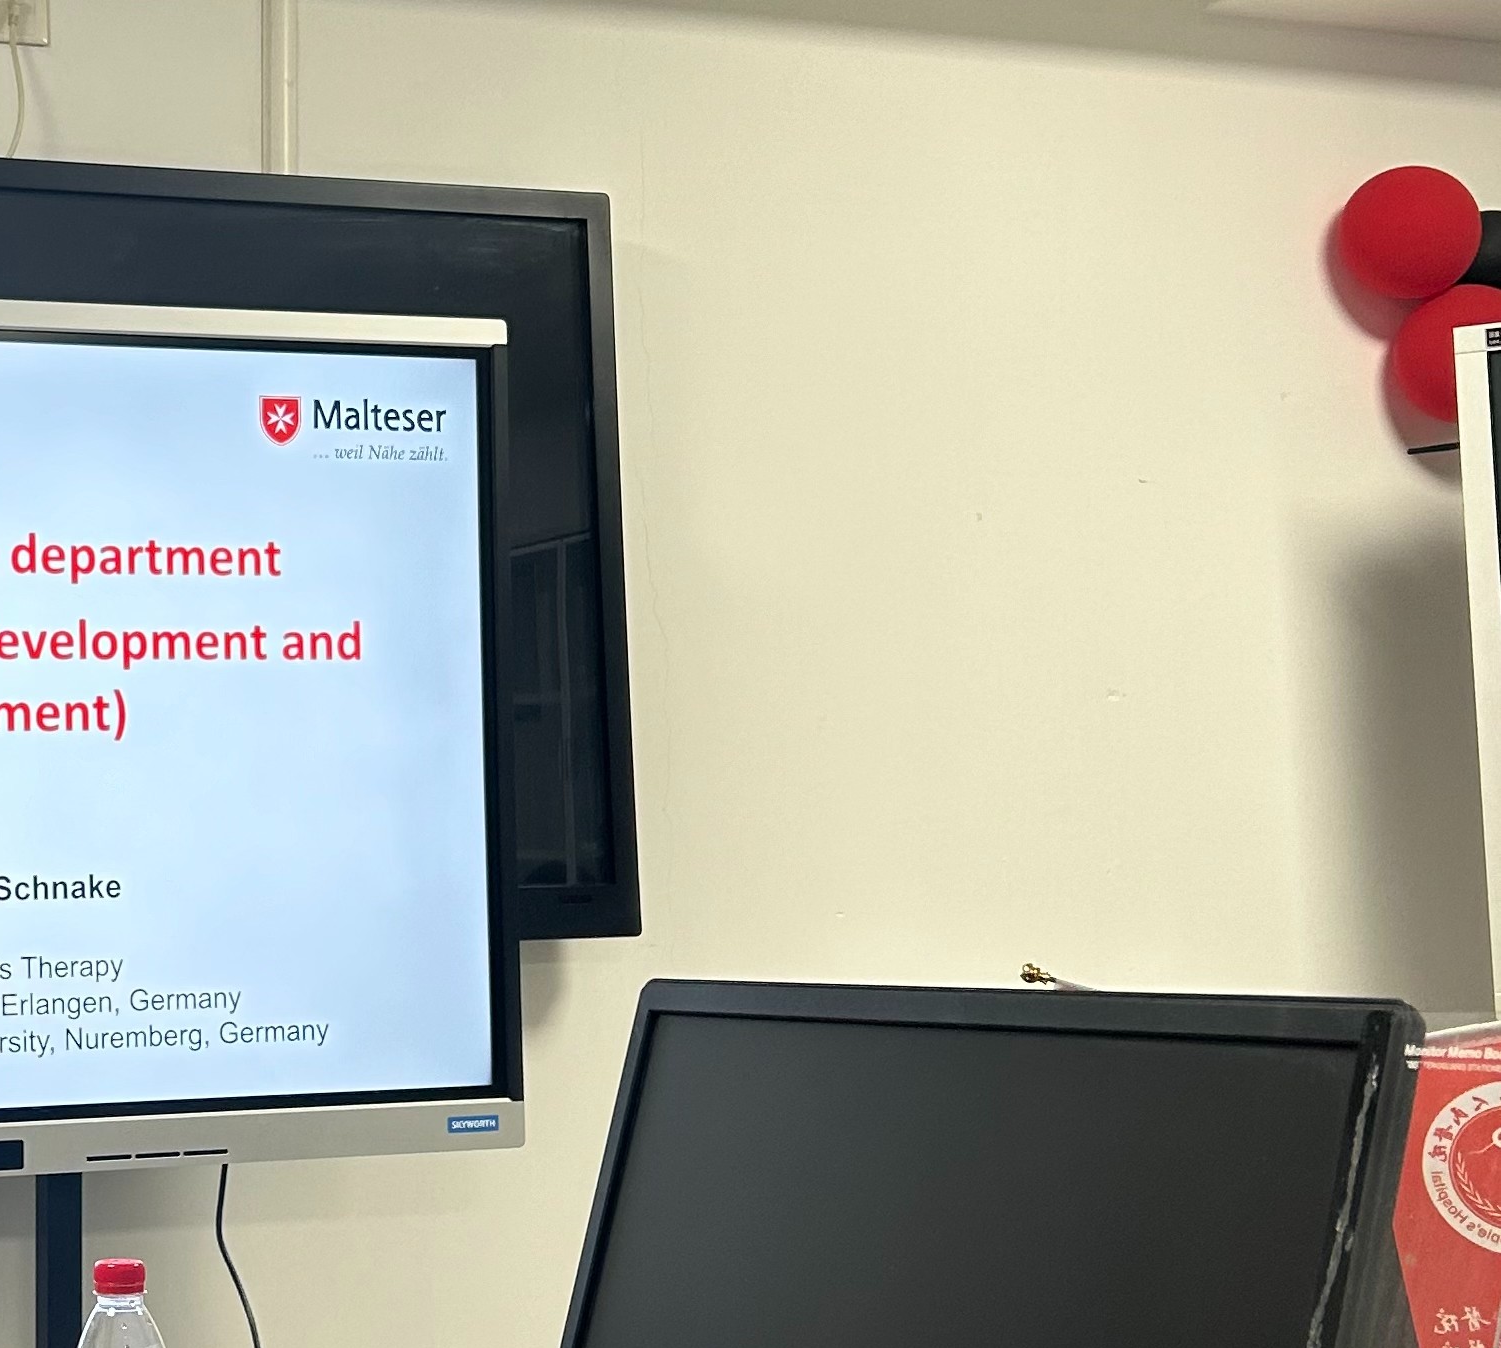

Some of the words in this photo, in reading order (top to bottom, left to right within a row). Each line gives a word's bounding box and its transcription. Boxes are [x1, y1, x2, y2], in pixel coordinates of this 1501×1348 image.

[314, 399, 446, 432] Malteser
[335, 445, 363, 459] weil
[369, 445, 405, 460] Nähe
[409, 446, 447, 461] zählt.
[12, 533, 280, 584] department
[283, 621, 360, 660] and
[21, 956, 123, 982] Therapy
[2, 993, 118, 1019] Erlangen,
[130, 989, 241, 1014] Germany
[66, 1025, 208, 1051] Nuremberg,
[220, 1022, 328, 1046] Germany
[451, 1119, 497, 1129] SKYWORTH
